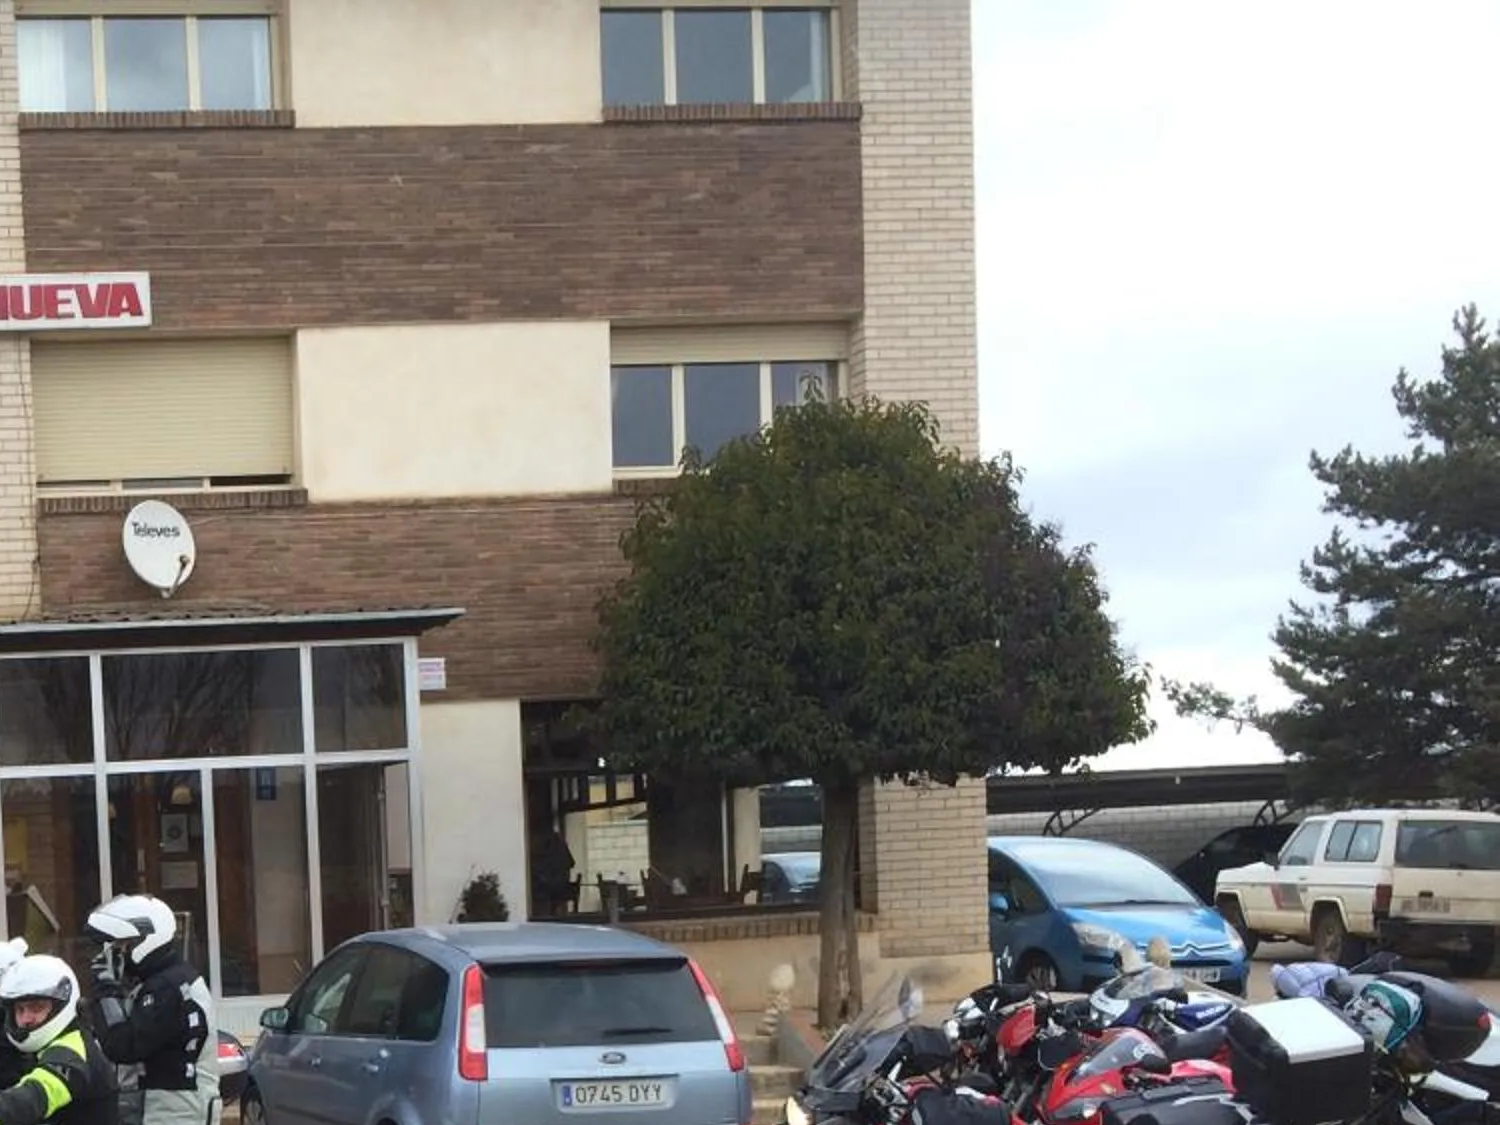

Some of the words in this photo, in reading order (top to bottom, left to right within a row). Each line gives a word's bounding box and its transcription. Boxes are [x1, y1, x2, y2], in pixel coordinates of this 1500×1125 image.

[131, 521, 180, 538] Televes
[575, 1085, 623, 1104] 0745
[629, 1084, 661, 1103] DYY
